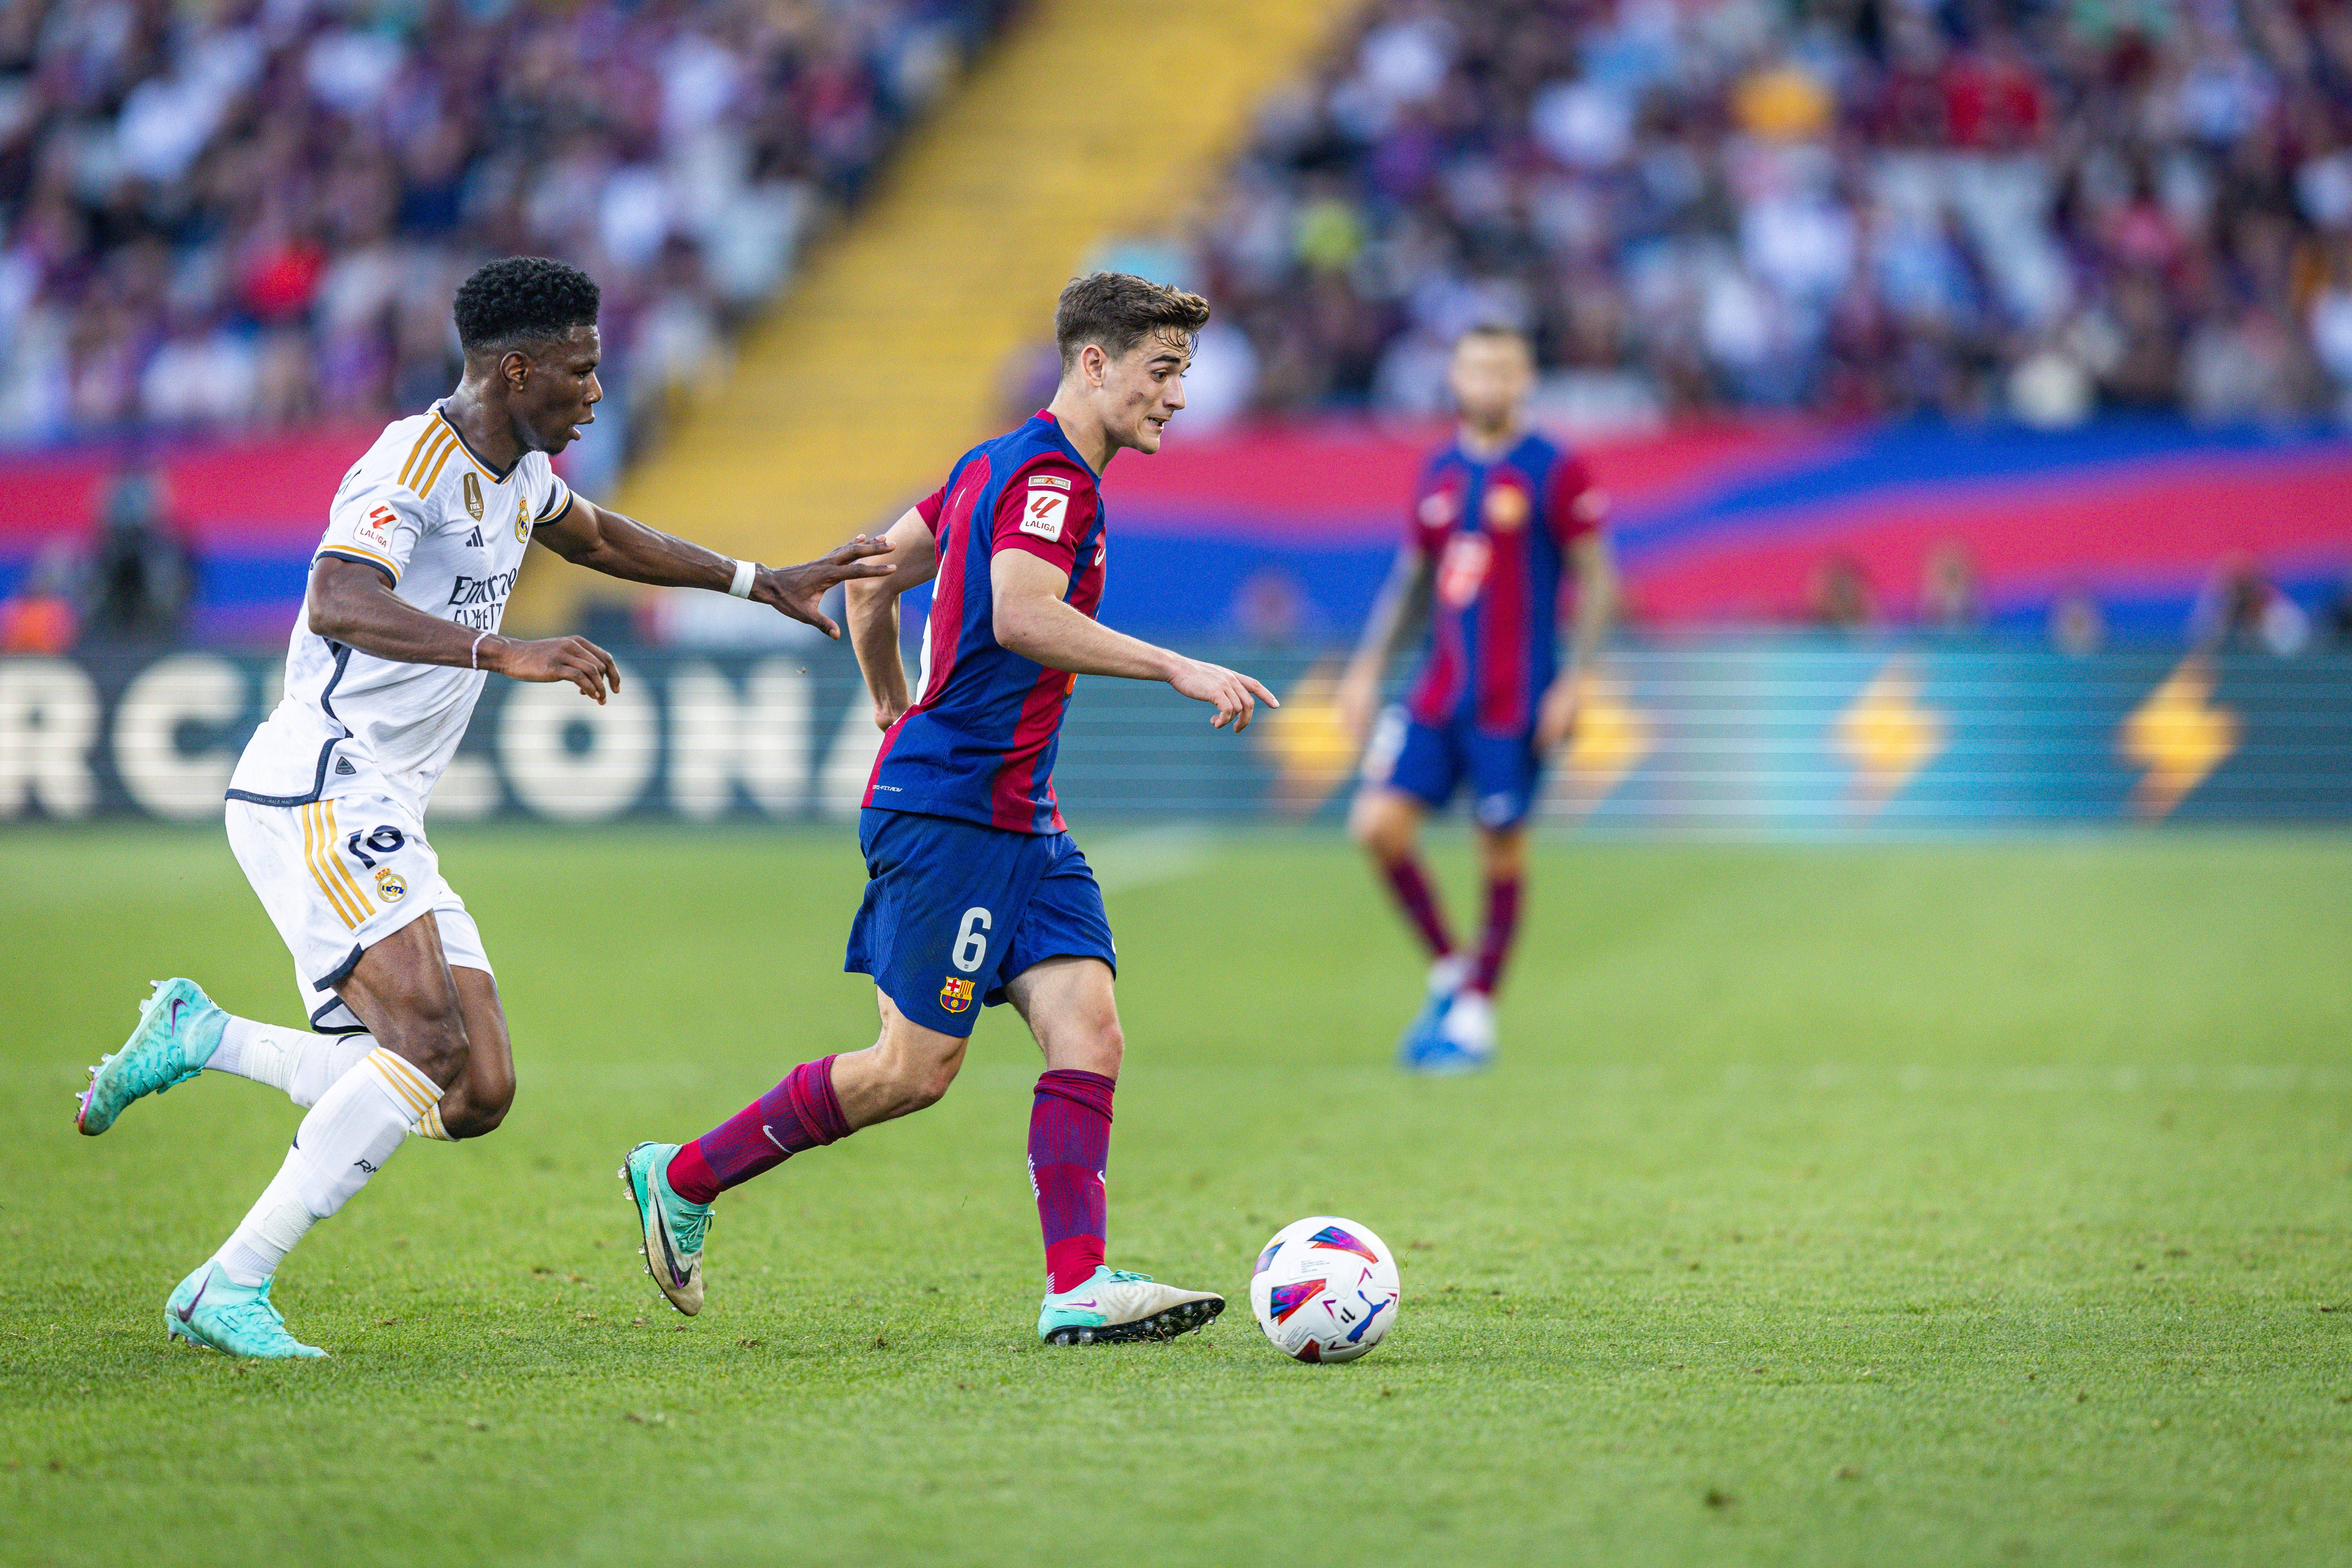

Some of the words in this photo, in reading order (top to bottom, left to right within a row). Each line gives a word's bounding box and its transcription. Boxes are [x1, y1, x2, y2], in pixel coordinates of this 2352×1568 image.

[1025, 521, 1055, 533] LALIGA
[360, 528, 387, 548] LALIGA
[953, 907, 992, 972] 6
